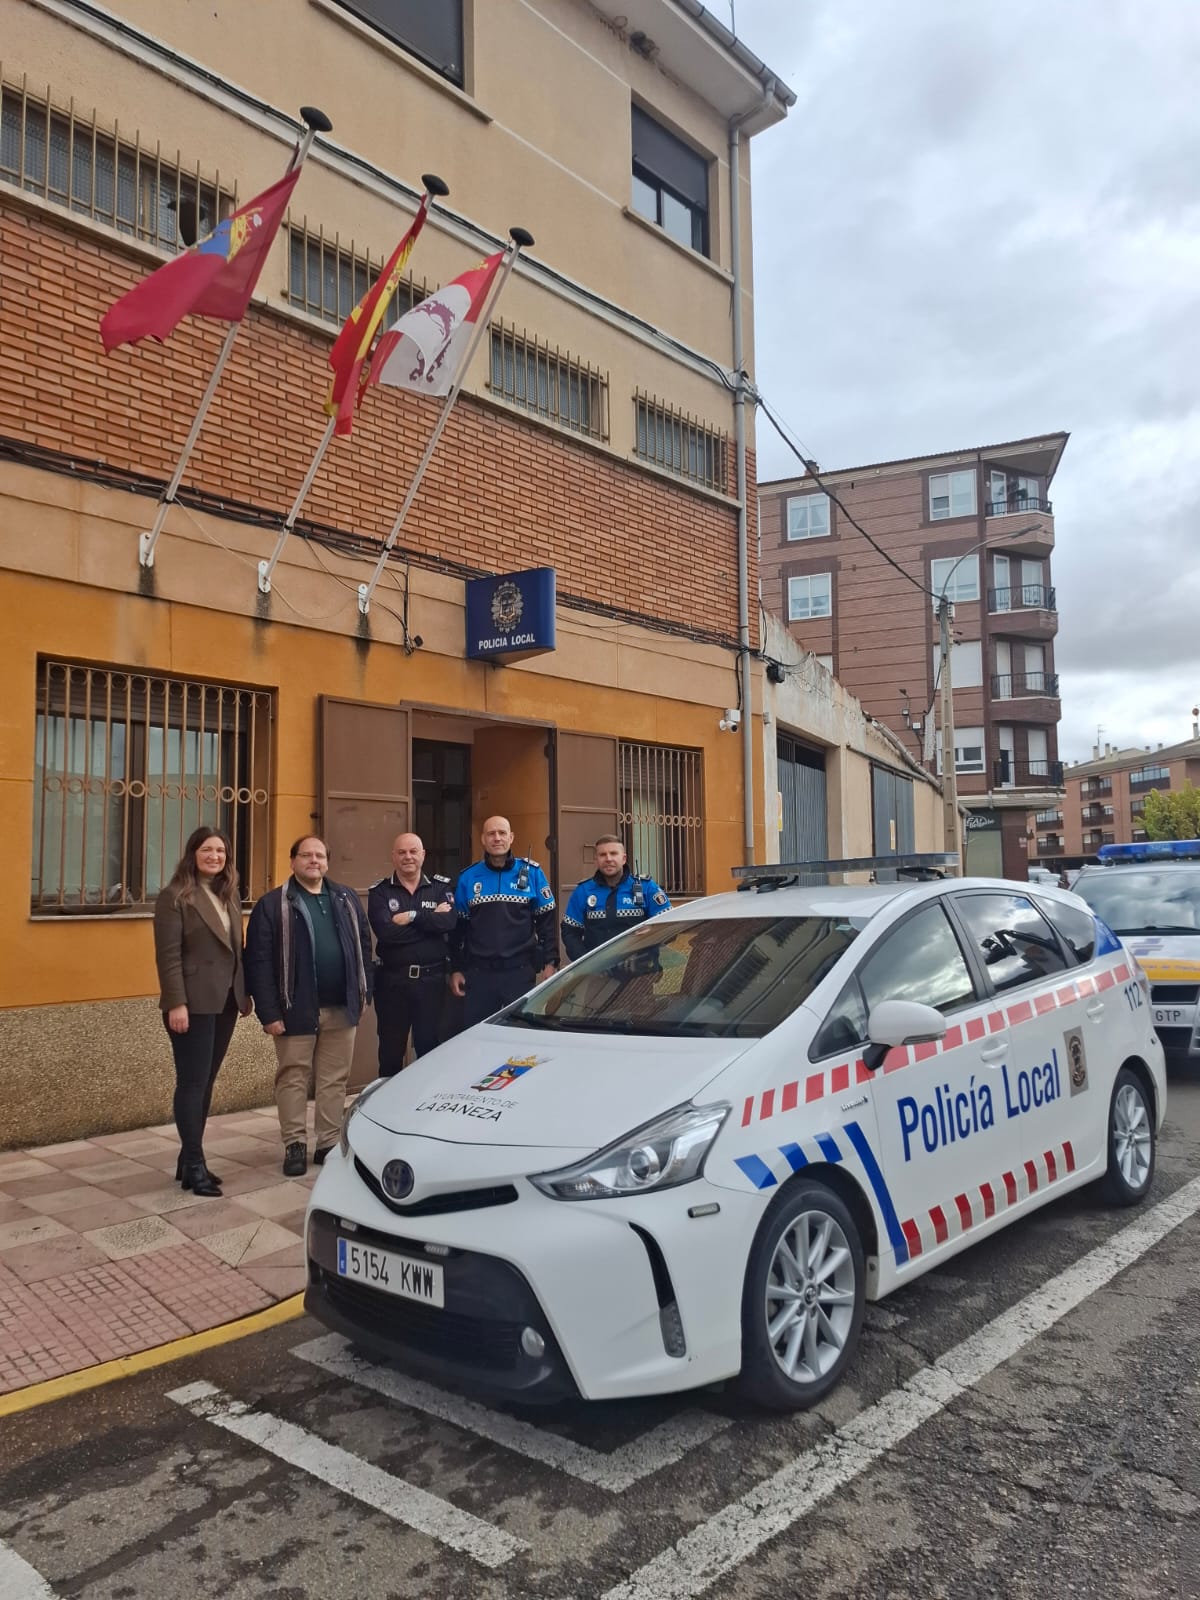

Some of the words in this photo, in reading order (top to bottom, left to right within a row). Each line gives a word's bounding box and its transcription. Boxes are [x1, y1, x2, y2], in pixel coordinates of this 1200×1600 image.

[478, 637, 508, 650] POLICIA
[511, 633, 536, 645] LOCAL
[1124, 981, 1143, 1011] 112
[1155, 1009, 1181, 1022] GTP
[896, 1075, 995, 1162] Policía
[1001, 1048, 1061, 1119] Local
[351, 1246, 390, 1285] 5154
[401, 1261, 433, 1298] KWW
